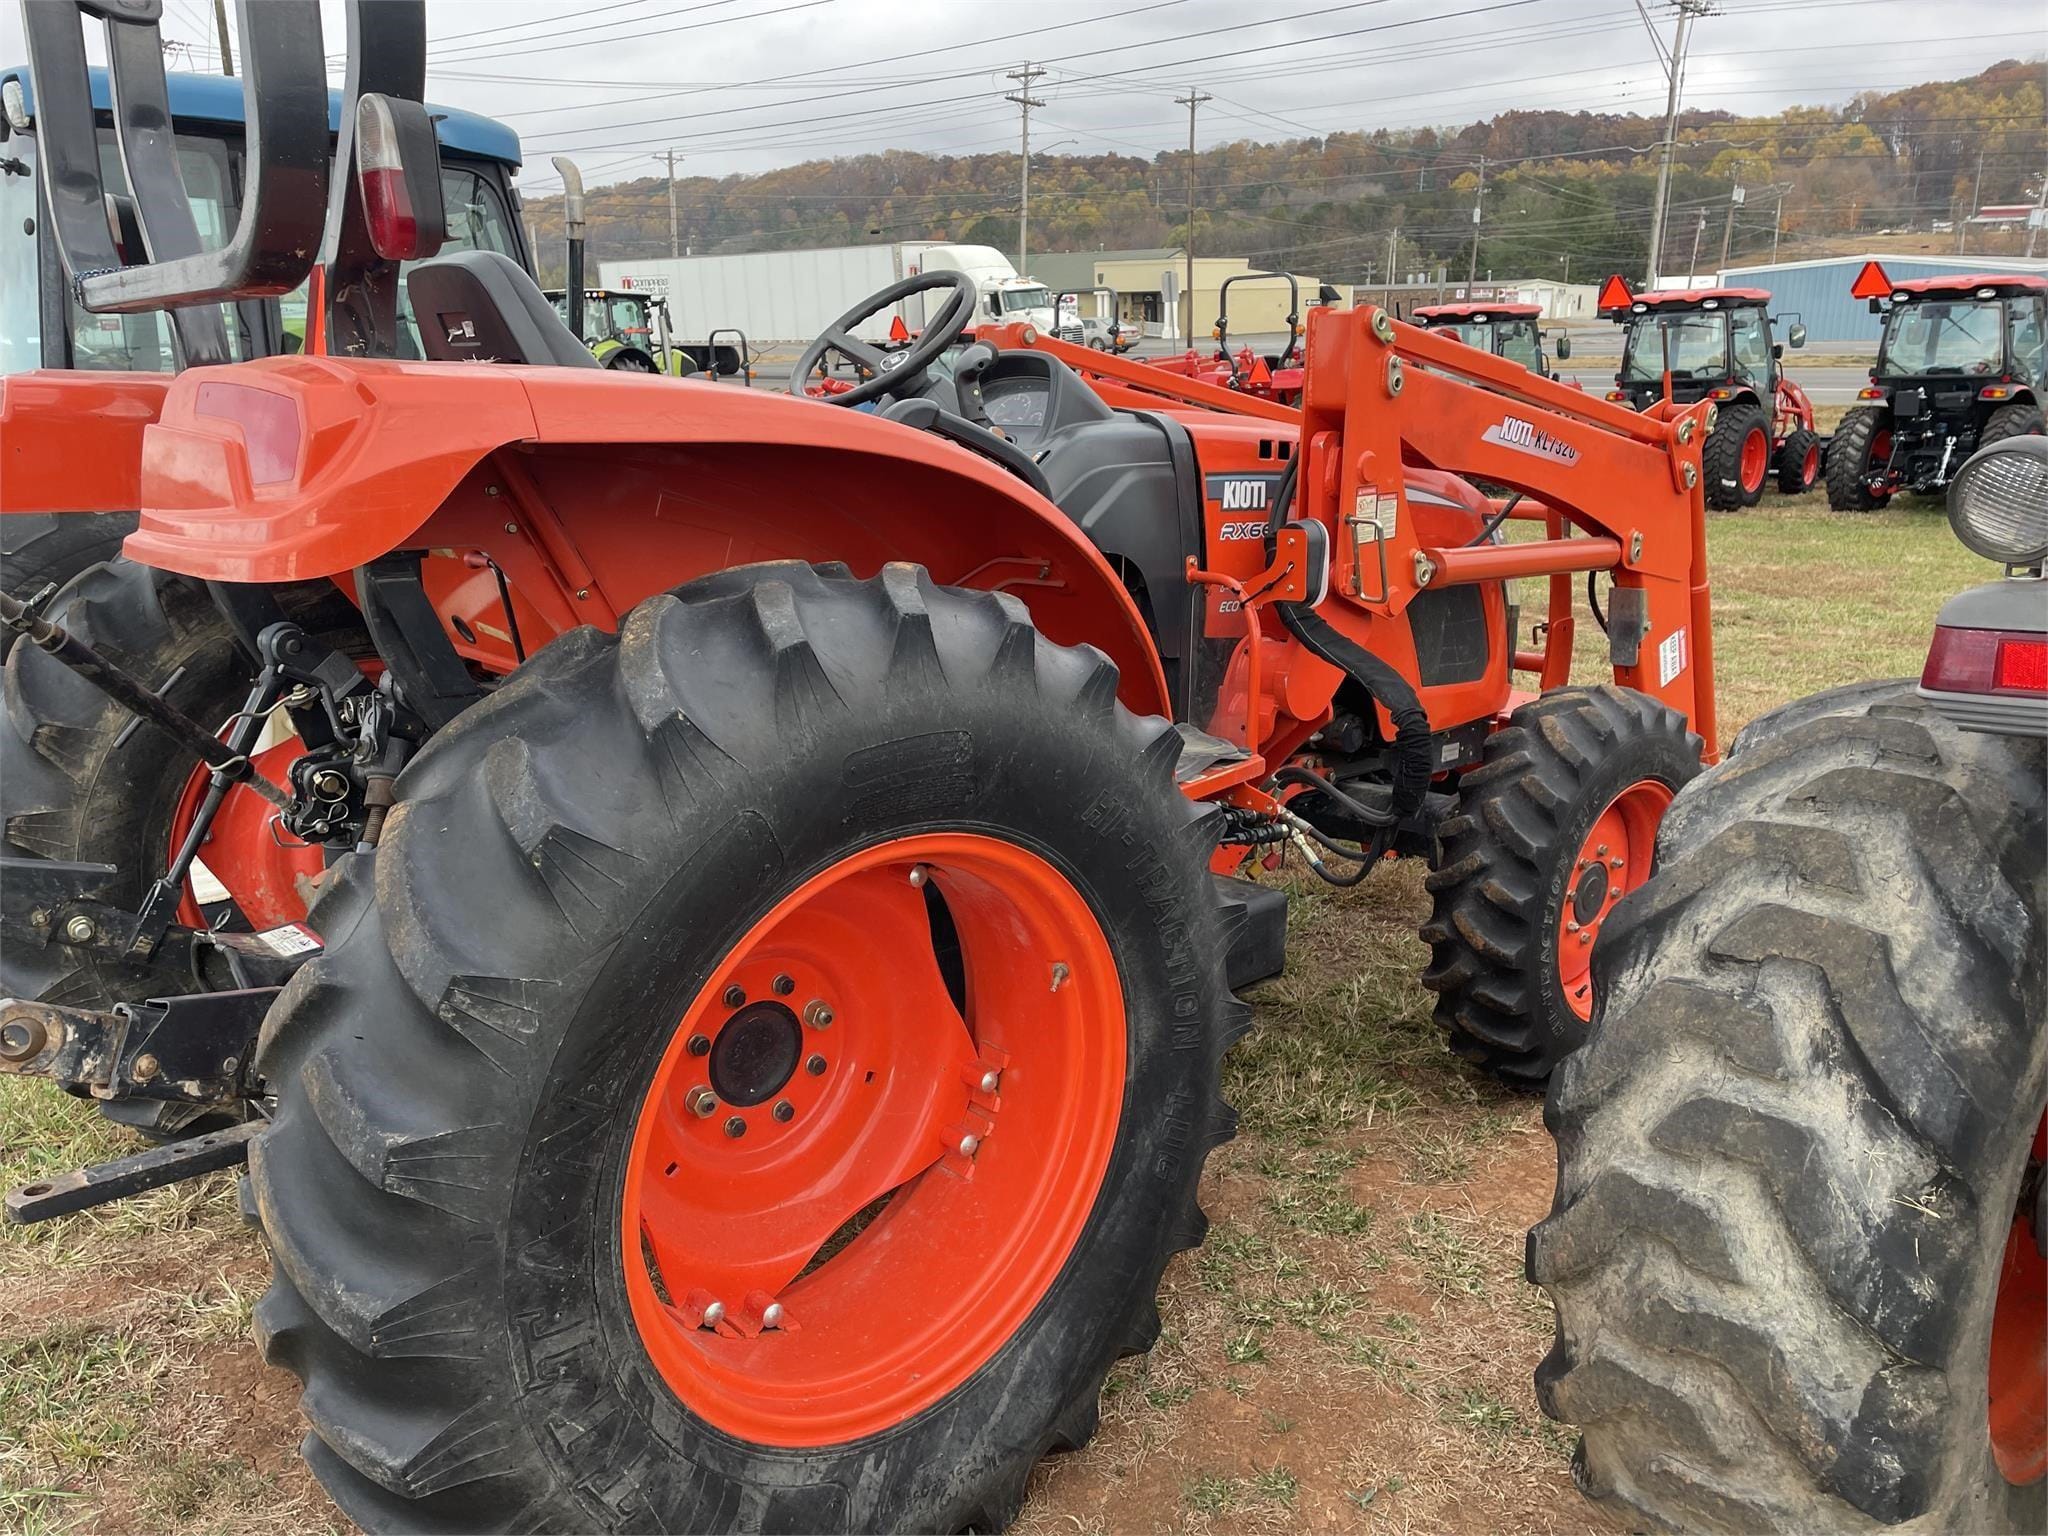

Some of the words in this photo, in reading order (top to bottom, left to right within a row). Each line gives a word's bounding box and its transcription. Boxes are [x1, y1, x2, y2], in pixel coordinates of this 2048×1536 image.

[1501, 415, 1534, 447] KIOTI
[1535, 430, 1576, 459] KL7320
[1222, 480, 1267, 510] KIOTI
[1153, 1089, 1195, 1184] LUG
